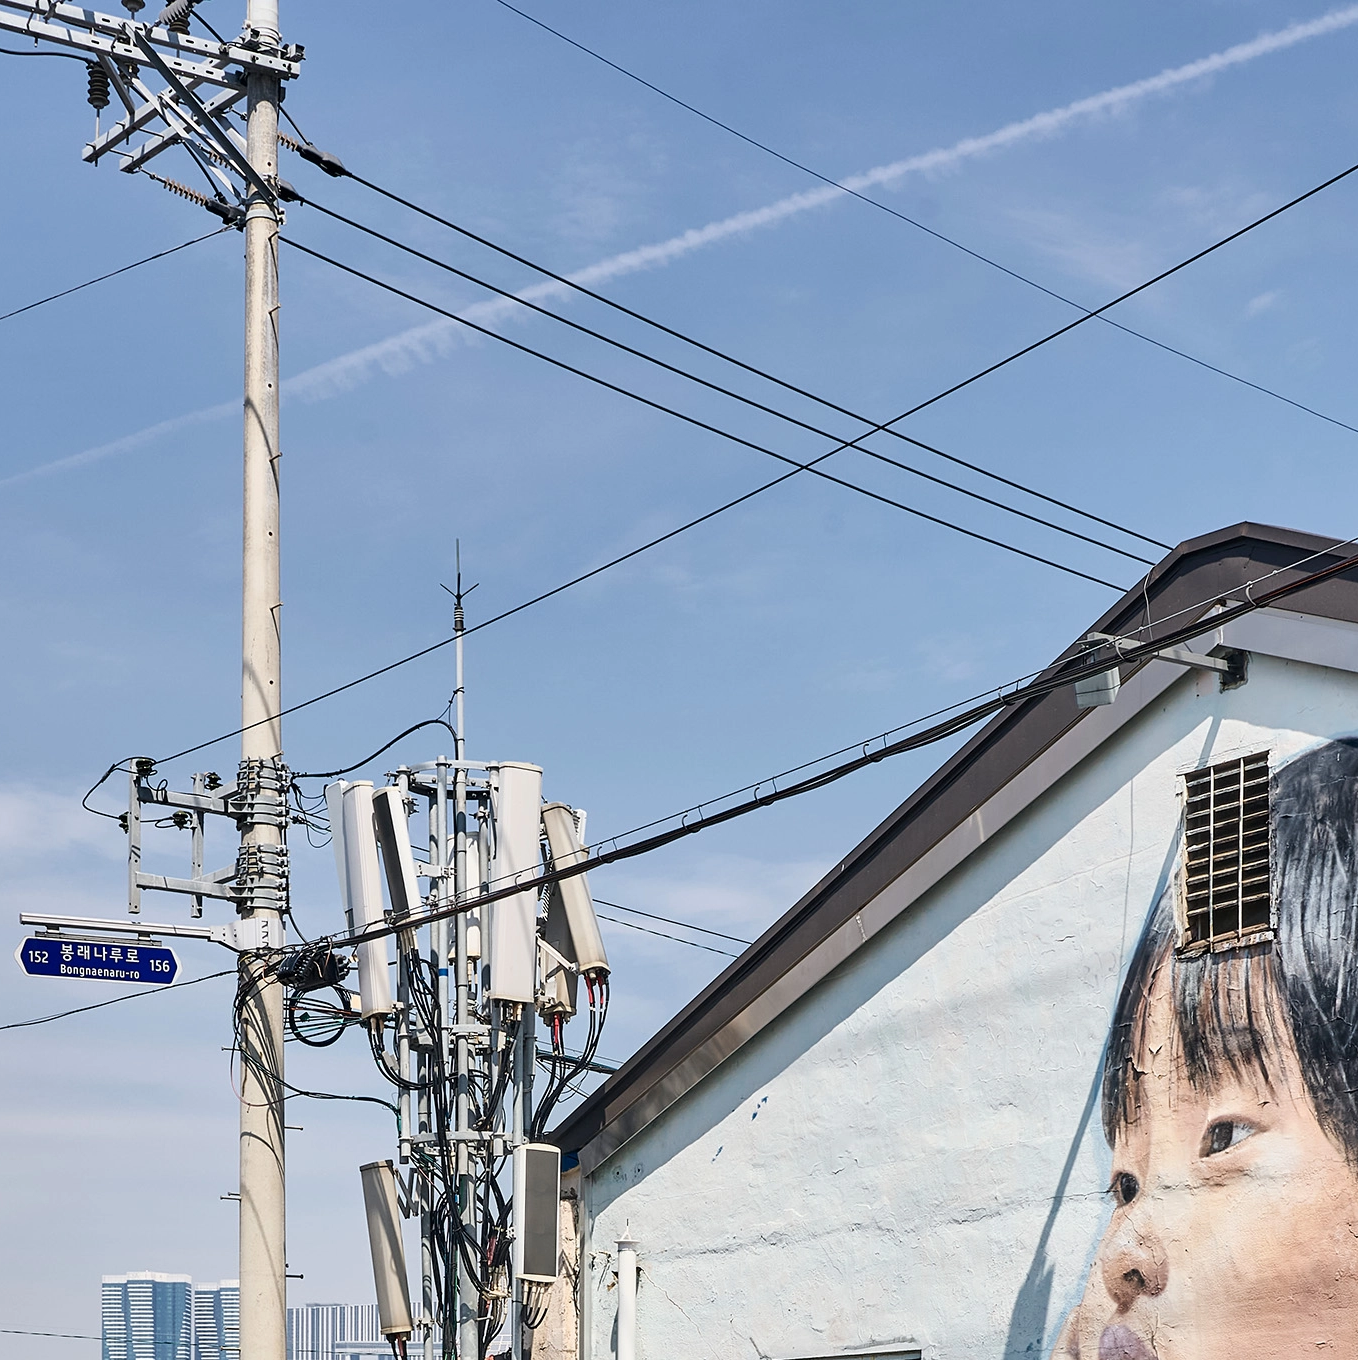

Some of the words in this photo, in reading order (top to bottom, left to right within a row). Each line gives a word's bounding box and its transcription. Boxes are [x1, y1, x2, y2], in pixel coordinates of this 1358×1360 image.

[28, 950, 49, 964] 152
[60, 944, 140, 964] 봉래나루로
[149, 959, 170, 973] 156
[60, 963, 140, 980] Bongnaenaru-ro
